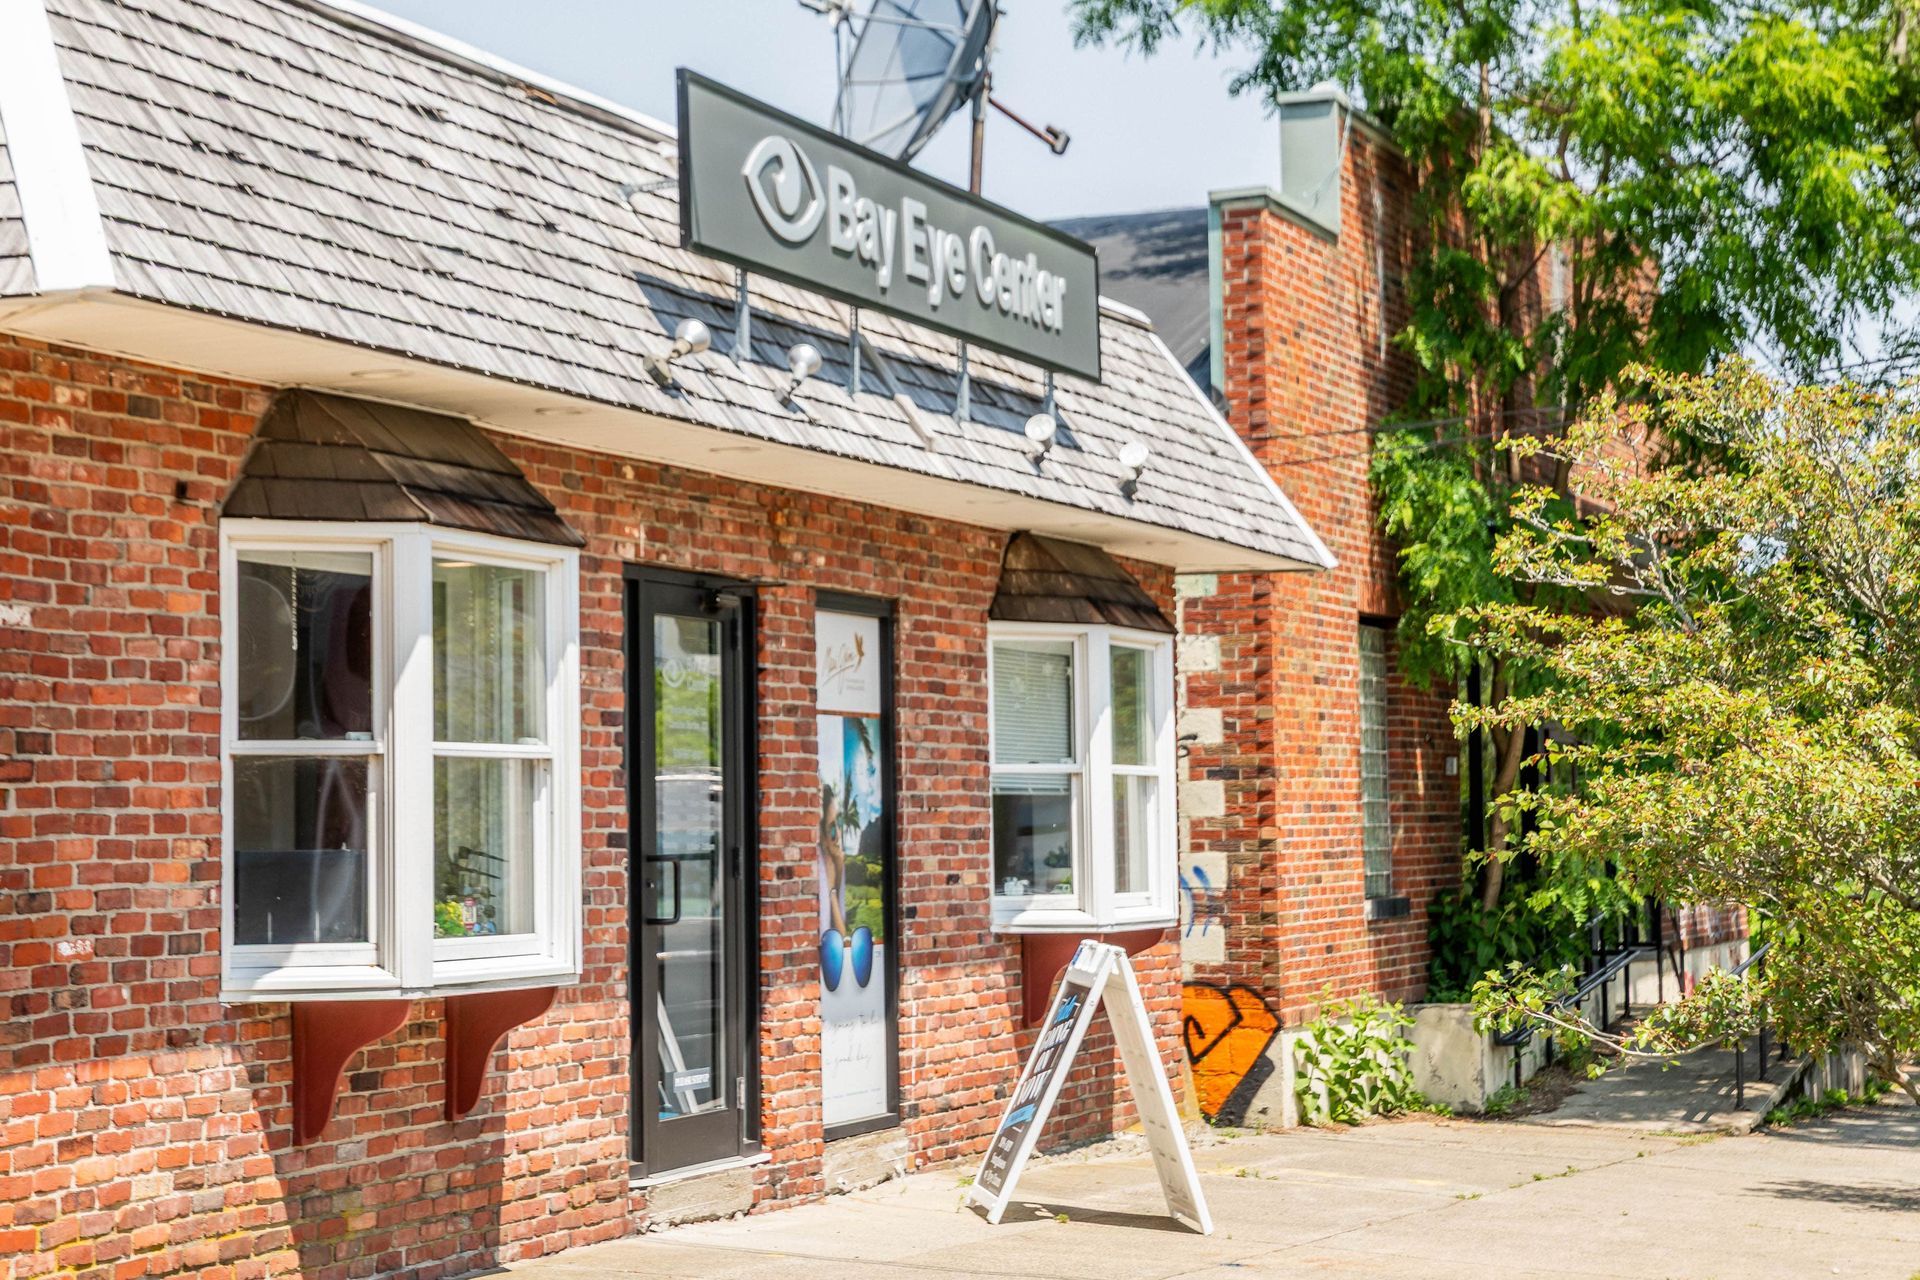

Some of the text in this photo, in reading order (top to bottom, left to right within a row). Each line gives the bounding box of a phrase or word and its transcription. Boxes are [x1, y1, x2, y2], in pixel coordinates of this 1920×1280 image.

[827, 164, 1067, 330] Bay Eye Center
